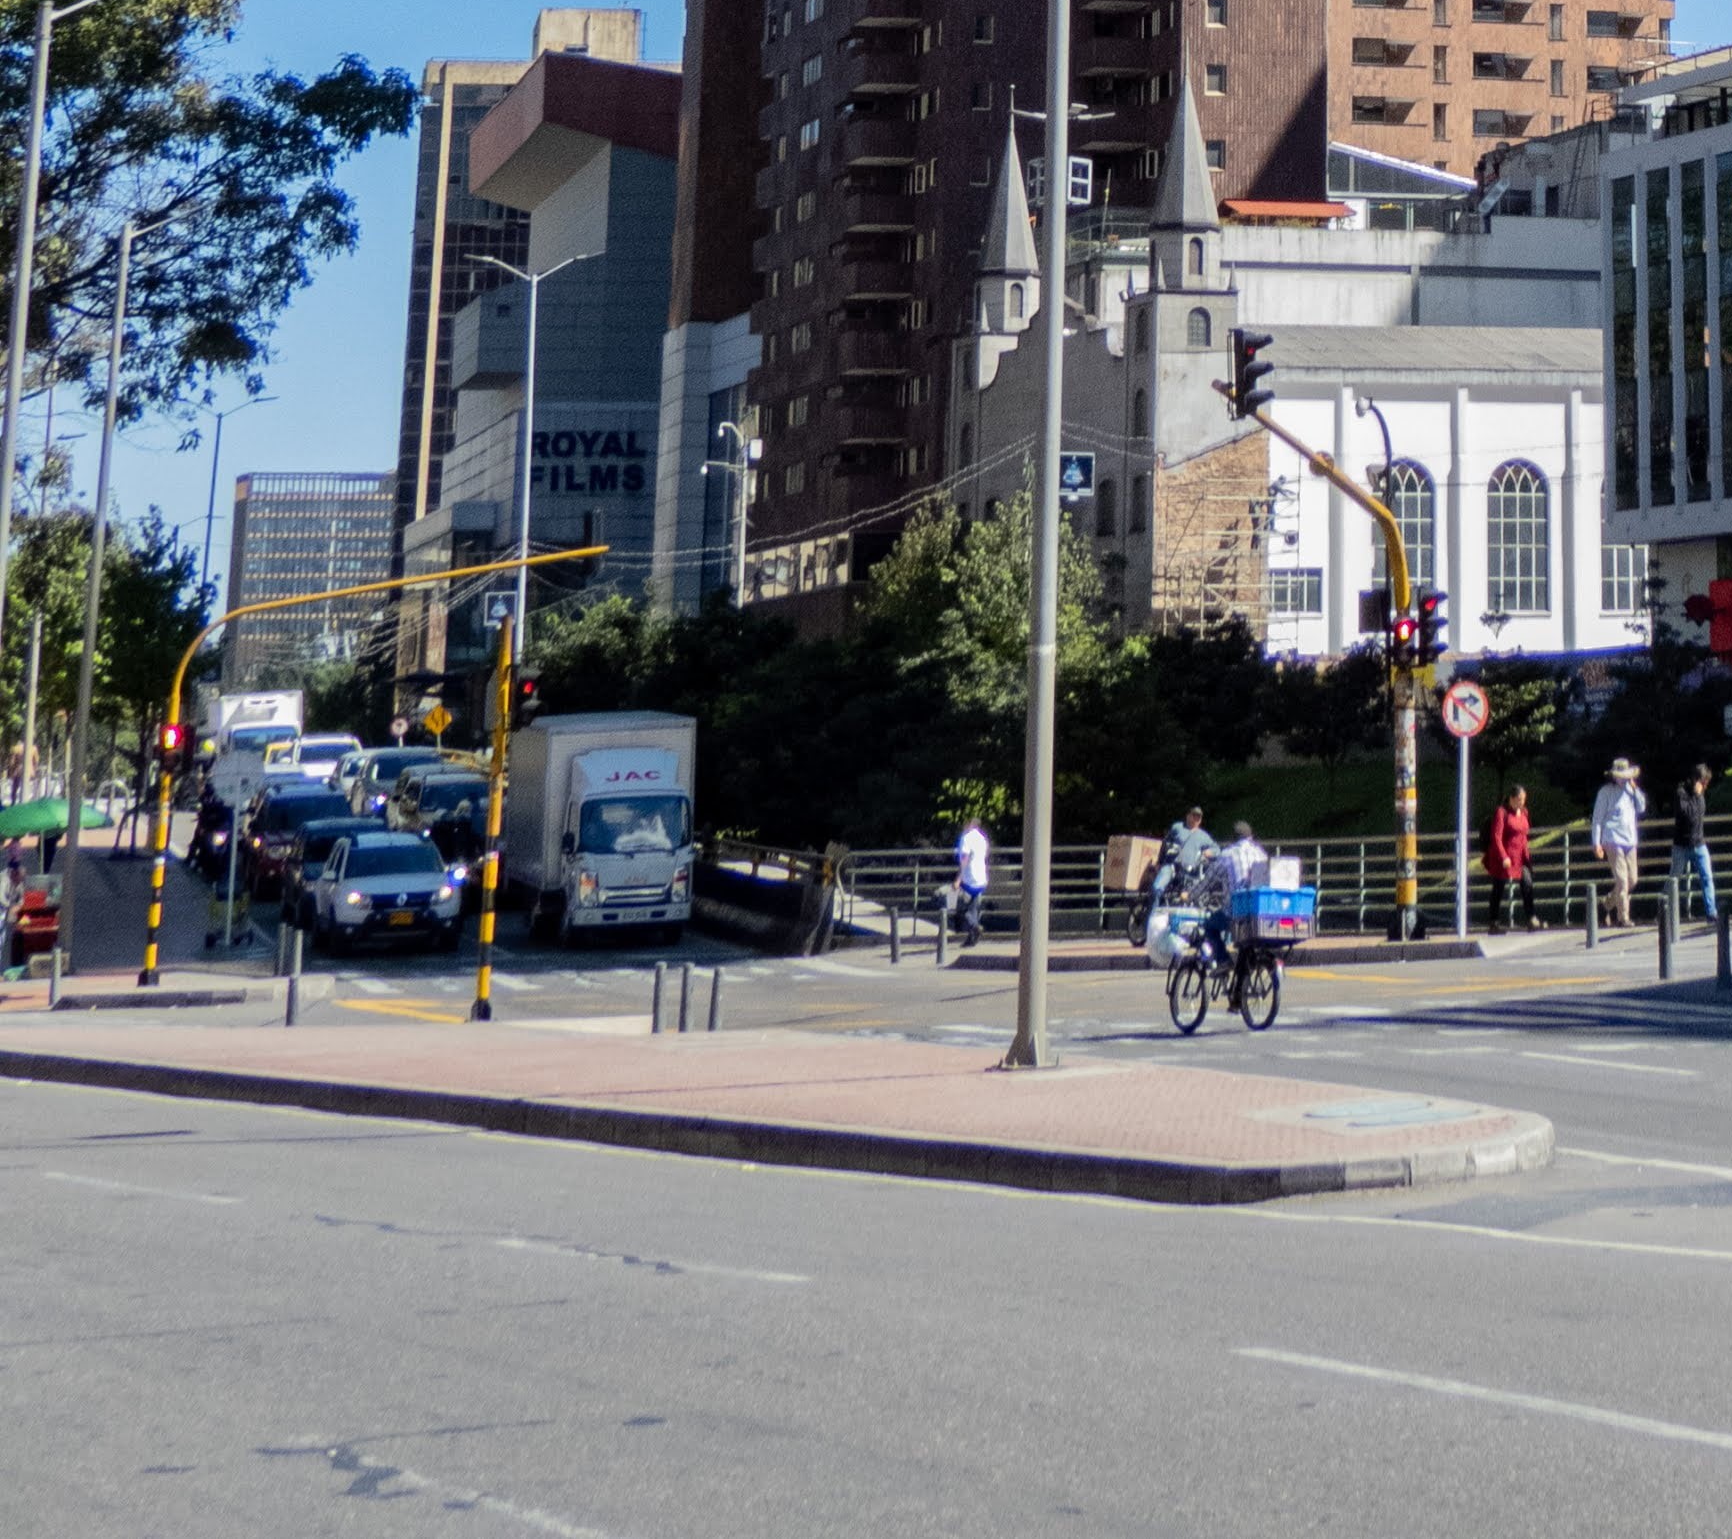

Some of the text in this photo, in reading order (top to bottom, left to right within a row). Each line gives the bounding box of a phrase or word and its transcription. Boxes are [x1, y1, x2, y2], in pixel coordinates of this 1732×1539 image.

[532, 430, 646, 458] ROYAL
[530, 464, 645, 491] FILMS
[605, 770, 661, 782] JAC
